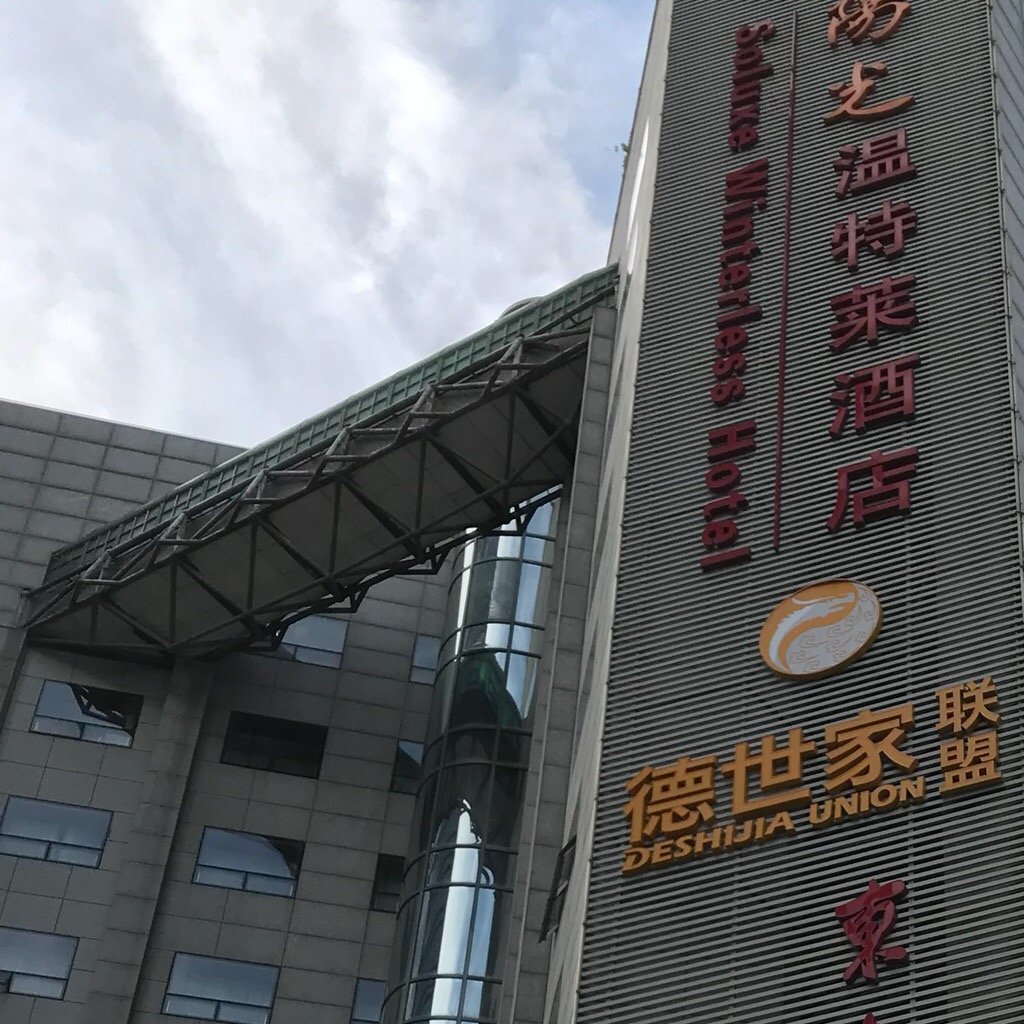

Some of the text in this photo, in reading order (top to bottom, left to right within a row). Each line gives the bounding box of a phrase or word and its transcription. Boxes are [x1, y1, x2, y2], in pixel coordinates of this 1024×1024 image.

[710, 156, 770, 406] Winterless
[700, 419, 758, 572] Hotel
[621, 776, 926, 876] DESHIJIA UNION
[622, 675, 1002, 847] 德世家 联盟
